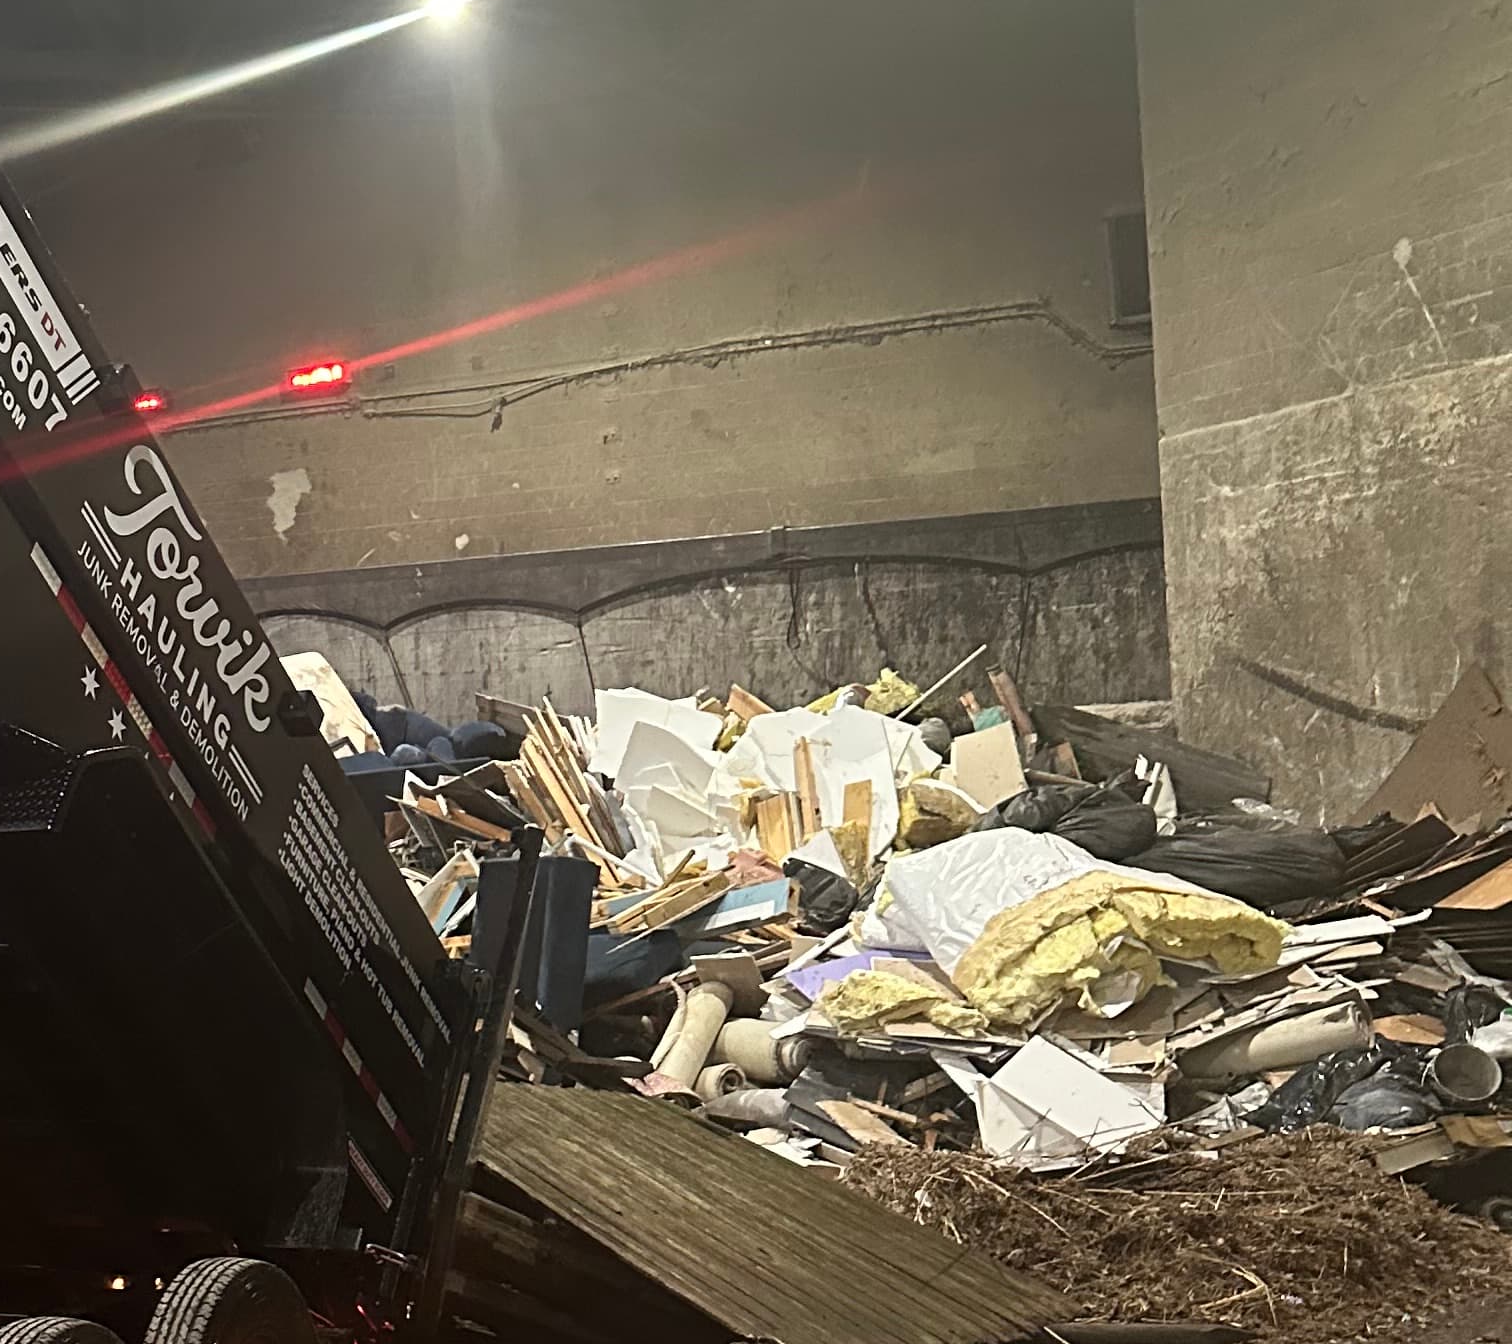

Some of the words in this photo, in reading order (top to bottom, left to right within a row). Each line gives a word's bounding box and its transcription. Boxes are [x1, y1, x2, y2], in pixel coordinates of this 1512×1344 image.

[77, 541, 113, 599] JUNK
[110, 592, 168, 694] REMOVAL
[169, 689, 180, 711] &
[180, 706, 249, 822] DEMOLITION
[103, 444, 271, 733] Torvik
[119, 557, 231, 751] HAULING
[290, 818, 324, 875] GARAGE
[321, 869, 368, 948] CLEAN-OUTS
[295, 800, 338, 870] BASEMENT
[335, 868, 380, 946] CLEAN-OUTS
[302, 763, 339, 828] SERVICES
[280, 849, 306, 893] LIGHT
[304, 890, 353, 971] DEMOLITION
[285, 833, 330, 916] FURNITURE,
[330, 908, 355, 950] PIANO
[360, 958, 379, 988] HOT
[377, 983, 393, 1014] TUB
[392, 1009, 425, 1068] REMOVAL
[300, 785, 348, 871] COMMERCIAL
[356, 878, 401, 959] RESIDENTIAL
[400, 956, 422, 992] JUNK
[420, 986, 451, 1044] REMOVAL
